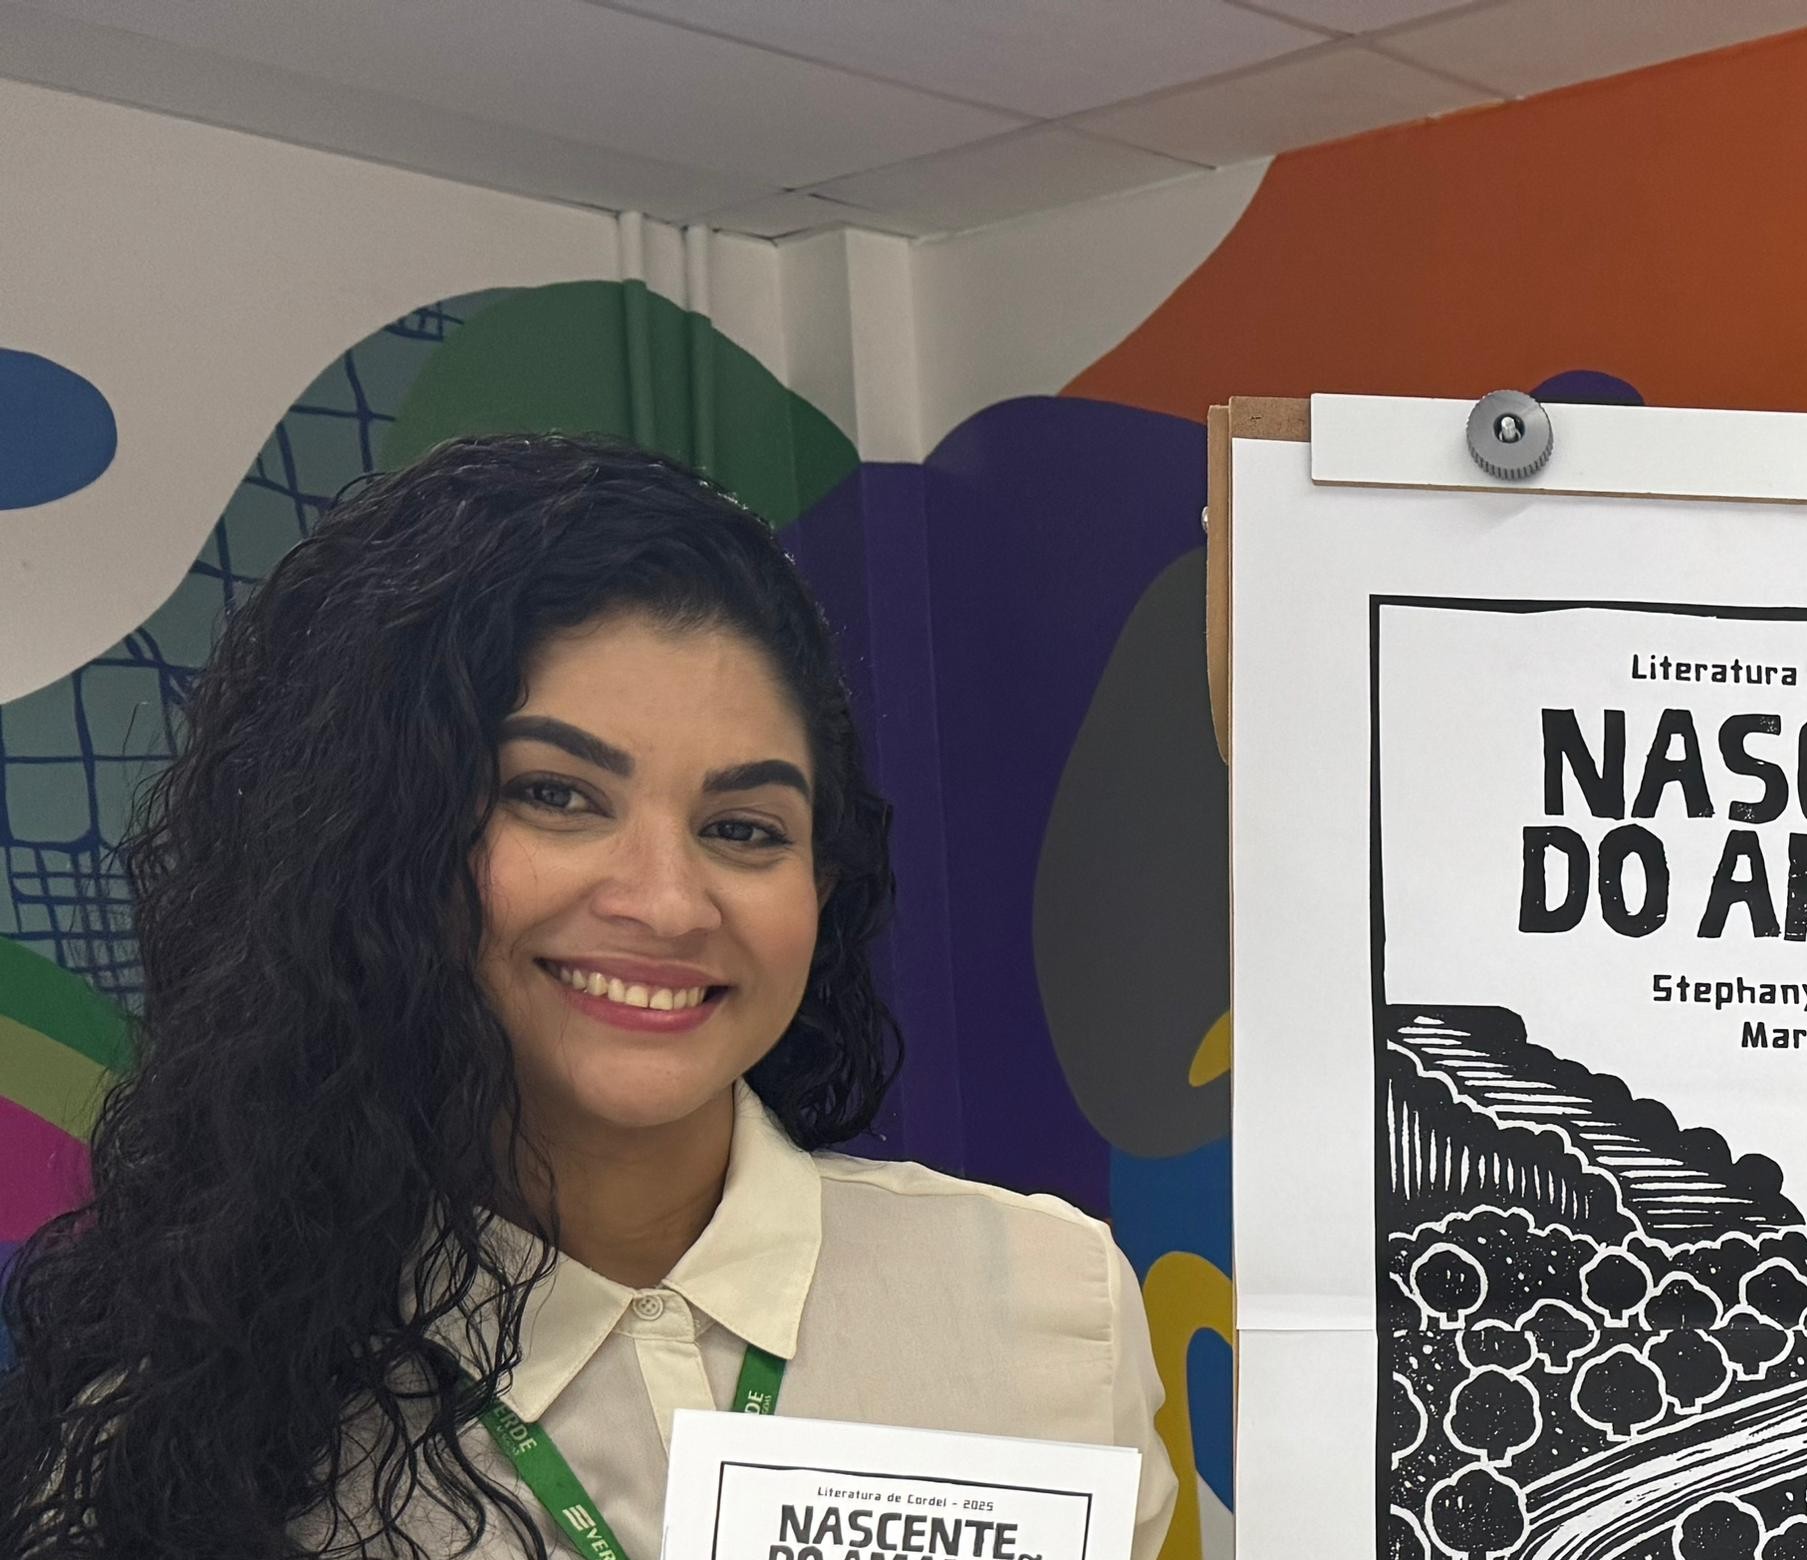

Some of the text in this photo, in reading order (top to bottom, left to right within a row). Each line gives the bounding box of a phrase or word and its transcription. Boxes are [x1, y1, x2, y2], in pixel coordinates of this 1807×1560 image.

[1632, 654, 1796, 686] Literatura
[1519, 824, 1669, 938] DO
[494, 1405, 537, 1453] ERDE
[818, 1488, 880, 1500] Literatura
[888, 1494, 900, 1502] de
[908, 1495, 946, 1506] Cordel
[964, 1500, 992, 1511] 2025
[780, 1505, 1017, 1560] NASCENTE
